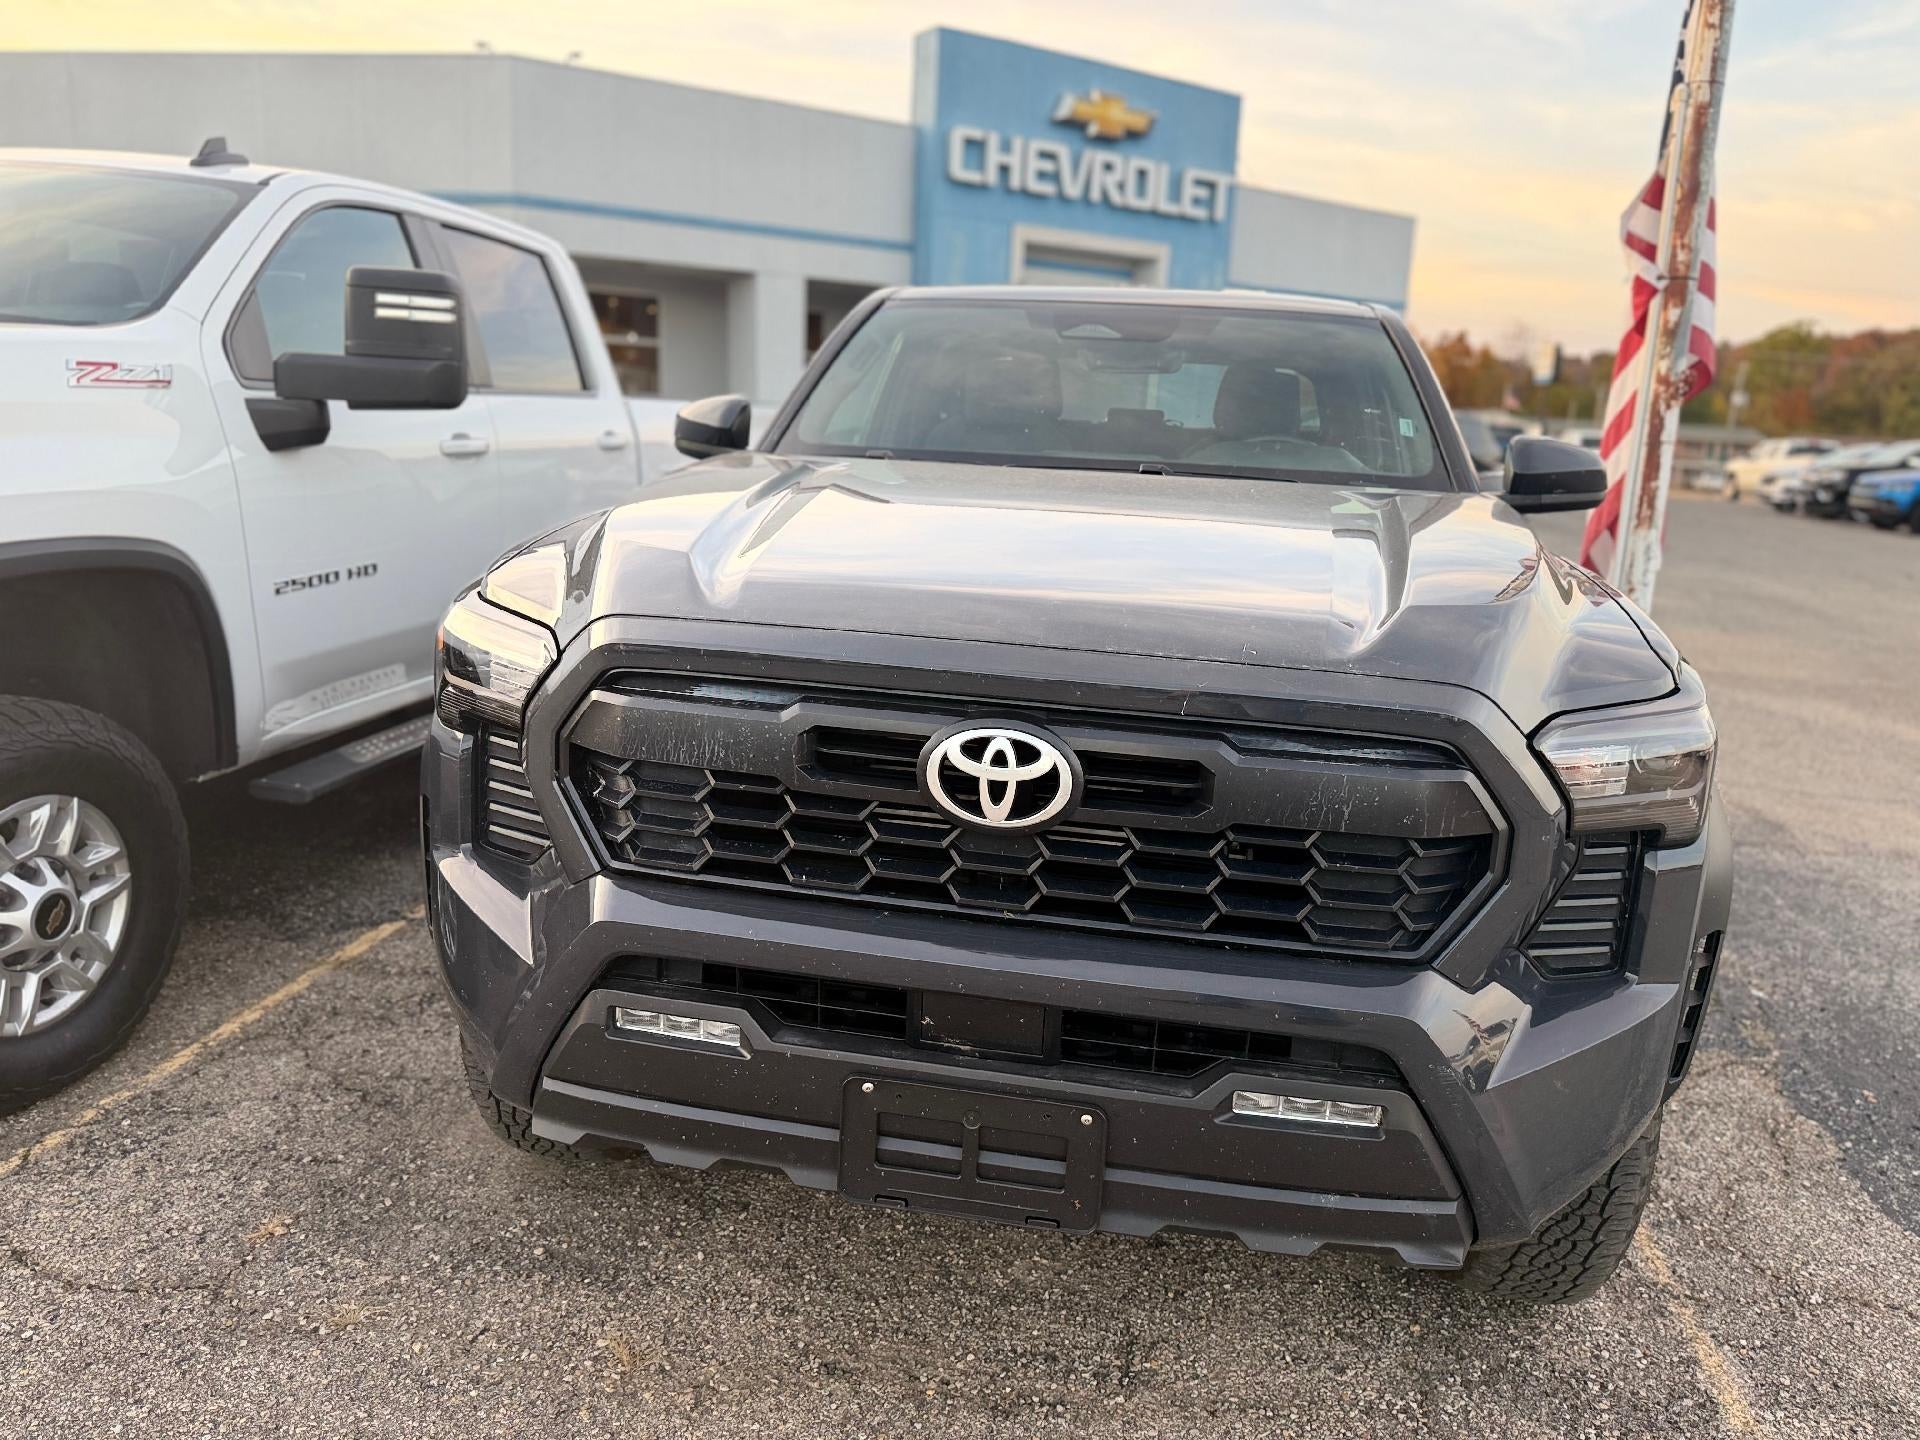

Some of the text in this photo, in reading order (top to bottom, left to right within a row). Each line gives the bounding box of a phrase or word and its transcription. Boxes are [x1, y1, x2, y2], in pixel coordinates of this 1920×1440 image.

[949, 126, 1232, 221] CHEVROLET
[273, 562, 378, 596] 2500 HD
